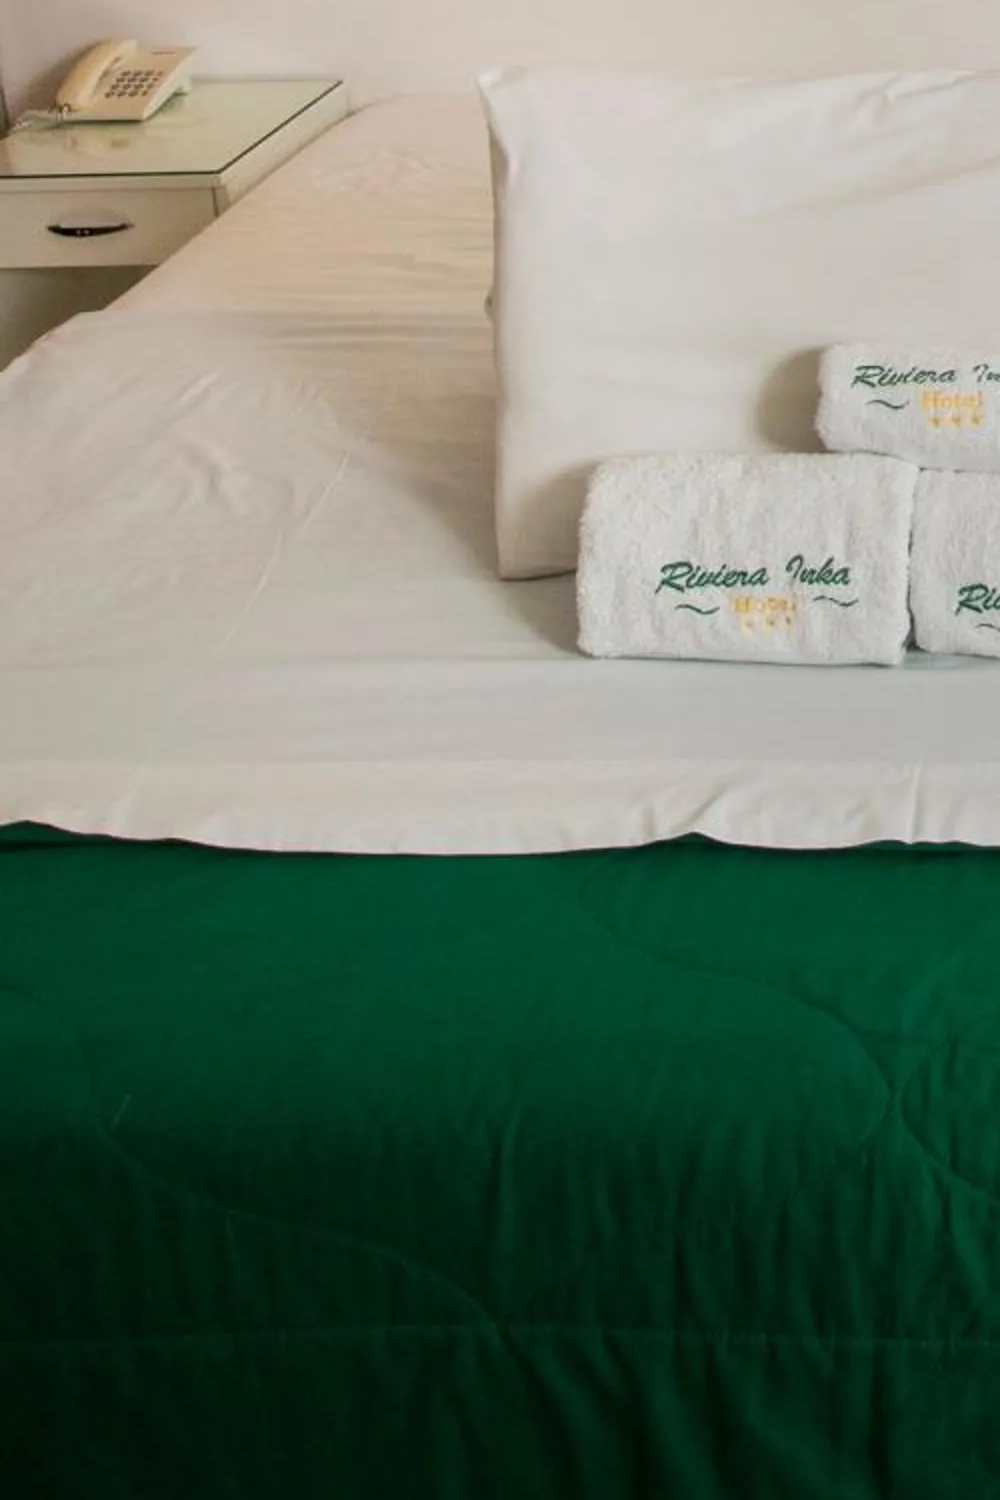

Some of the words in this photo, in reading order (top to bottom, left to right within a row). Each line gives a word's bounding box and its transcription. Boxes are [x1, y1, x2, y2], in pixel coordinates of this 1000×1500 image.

[851, 364, 958, 388] Riviera
[922, 389, 983, 408] Hotel
[654, 560, 771, 594] Riviera
[785, 553, 851, 586] Inka
